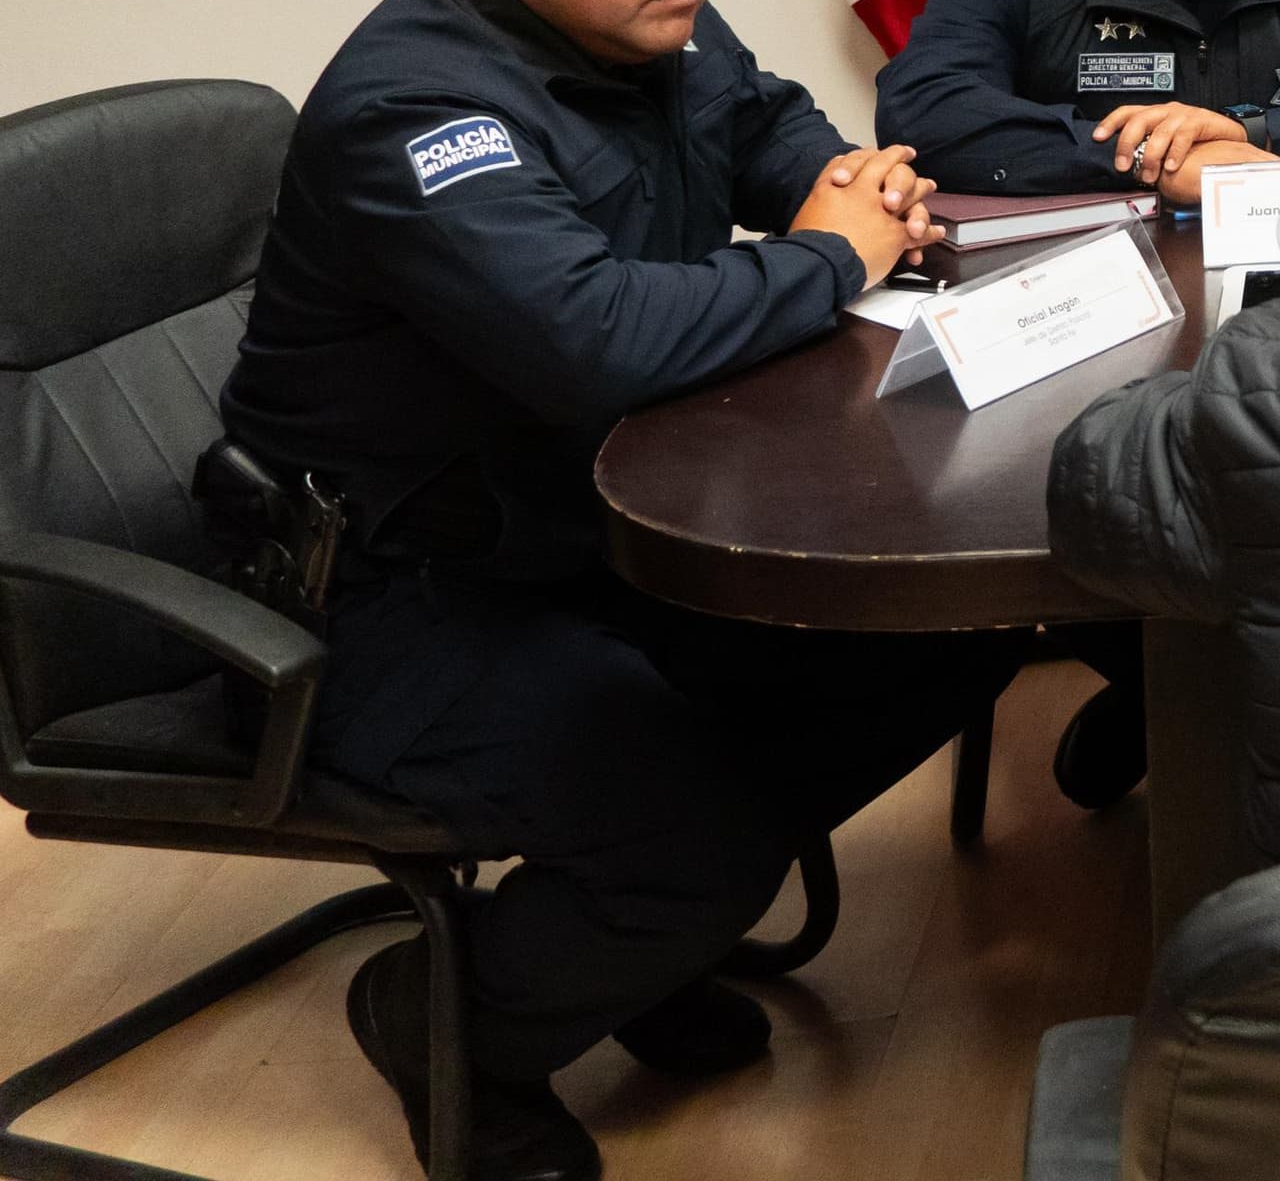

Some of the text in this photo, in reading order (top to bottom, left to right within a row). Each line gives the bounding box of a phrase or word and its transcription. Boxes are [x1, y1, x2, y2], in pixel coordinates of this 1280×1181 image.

[414, 125, 506, 168] POLICÍA
[419, 140, 511, 179] MUNICIPAL
[1247, 206, 1280, 217] Juan
[1017, 308, 1048, 329] Oficial
